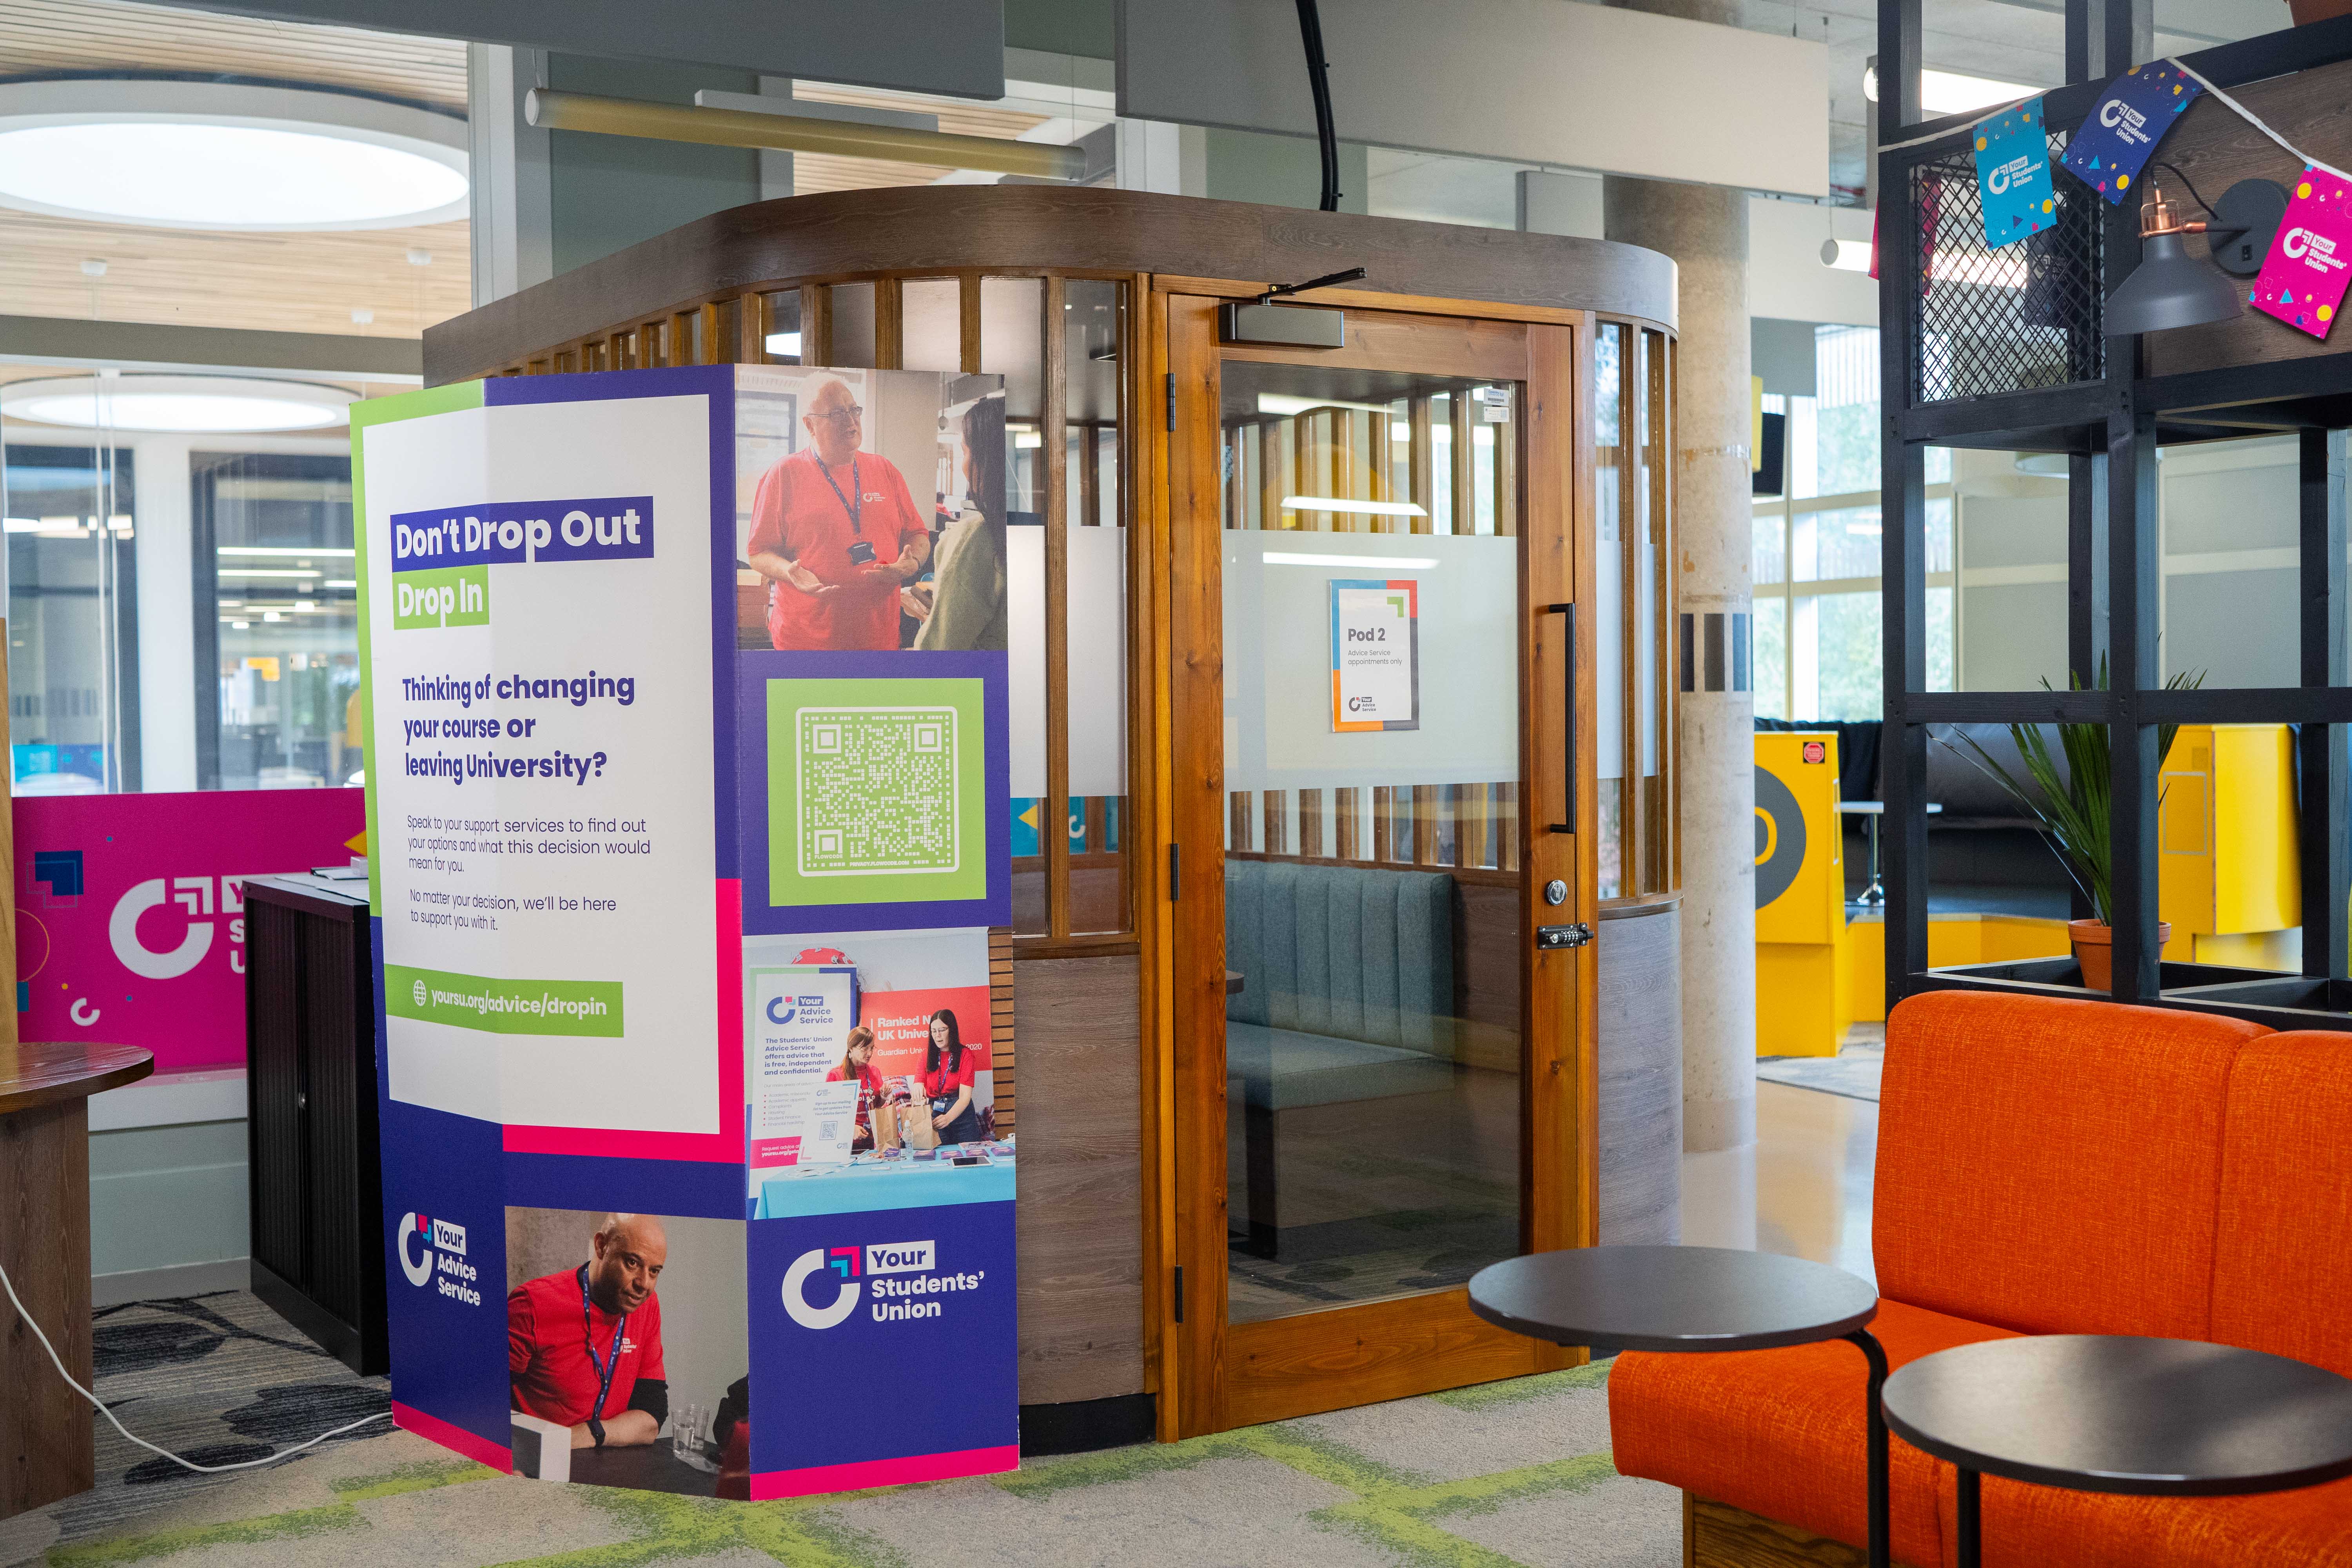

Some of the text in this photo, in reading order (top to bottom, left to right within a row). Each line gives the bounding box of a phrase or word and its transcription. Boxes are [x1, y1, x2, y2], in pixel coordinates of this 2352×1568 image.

[2128, 111, 2143, 124] Your
[2116, 128, 2134, 145] Union
[2121, 120, 2151, 143] Students'
[2011, 160, 2026, 169] Your
[2012, 161, 2043, 179] Students'
[2013, 175, 2032, 187] Union
[2315, 238, 2332, 250] Your
[2305, 257, 2328, 273] Union
[2308, 249, 2347, 269] Students'
[396, 509, 641, 562] Don't Drop Out
[398, 578, 483, 627] Drop In
[1348, 628, 1385, 641] Pod 2
[403, 670, 634, 708] Thinking of changing
[404, 717, 536, 746] your course or
[406, 750, 607, 786] leaving University?
[408, 815, 646, 836] Speak to your support services to find out
[408, 836, 650, 854] your options and what this decision would
[409, 857, 464, 875] mean for you.
[410, 889, 616, 912] No matter your decision, we'll be here
[411, 909, 418, 922] to
[421, 911, 452, 928] support
[454, 915, 468, 930] you
[471, 915, 488, 929] with
[432, 989, 607, 1020] yoursu.org/advice/dropin
[878, 1016, 919, 1027] Ranked
[878, 1030, 895, 1041] UK
[436, 1225, 463, 1249] Your
[437, 1253, 476, 1282] Advice
[871, 1249, 926, 1268] Your
[438, 1276, 480, 1306] Service
[872, 1271, 984, 1298] Students'
[872, 1299, 941, 1321] Union
